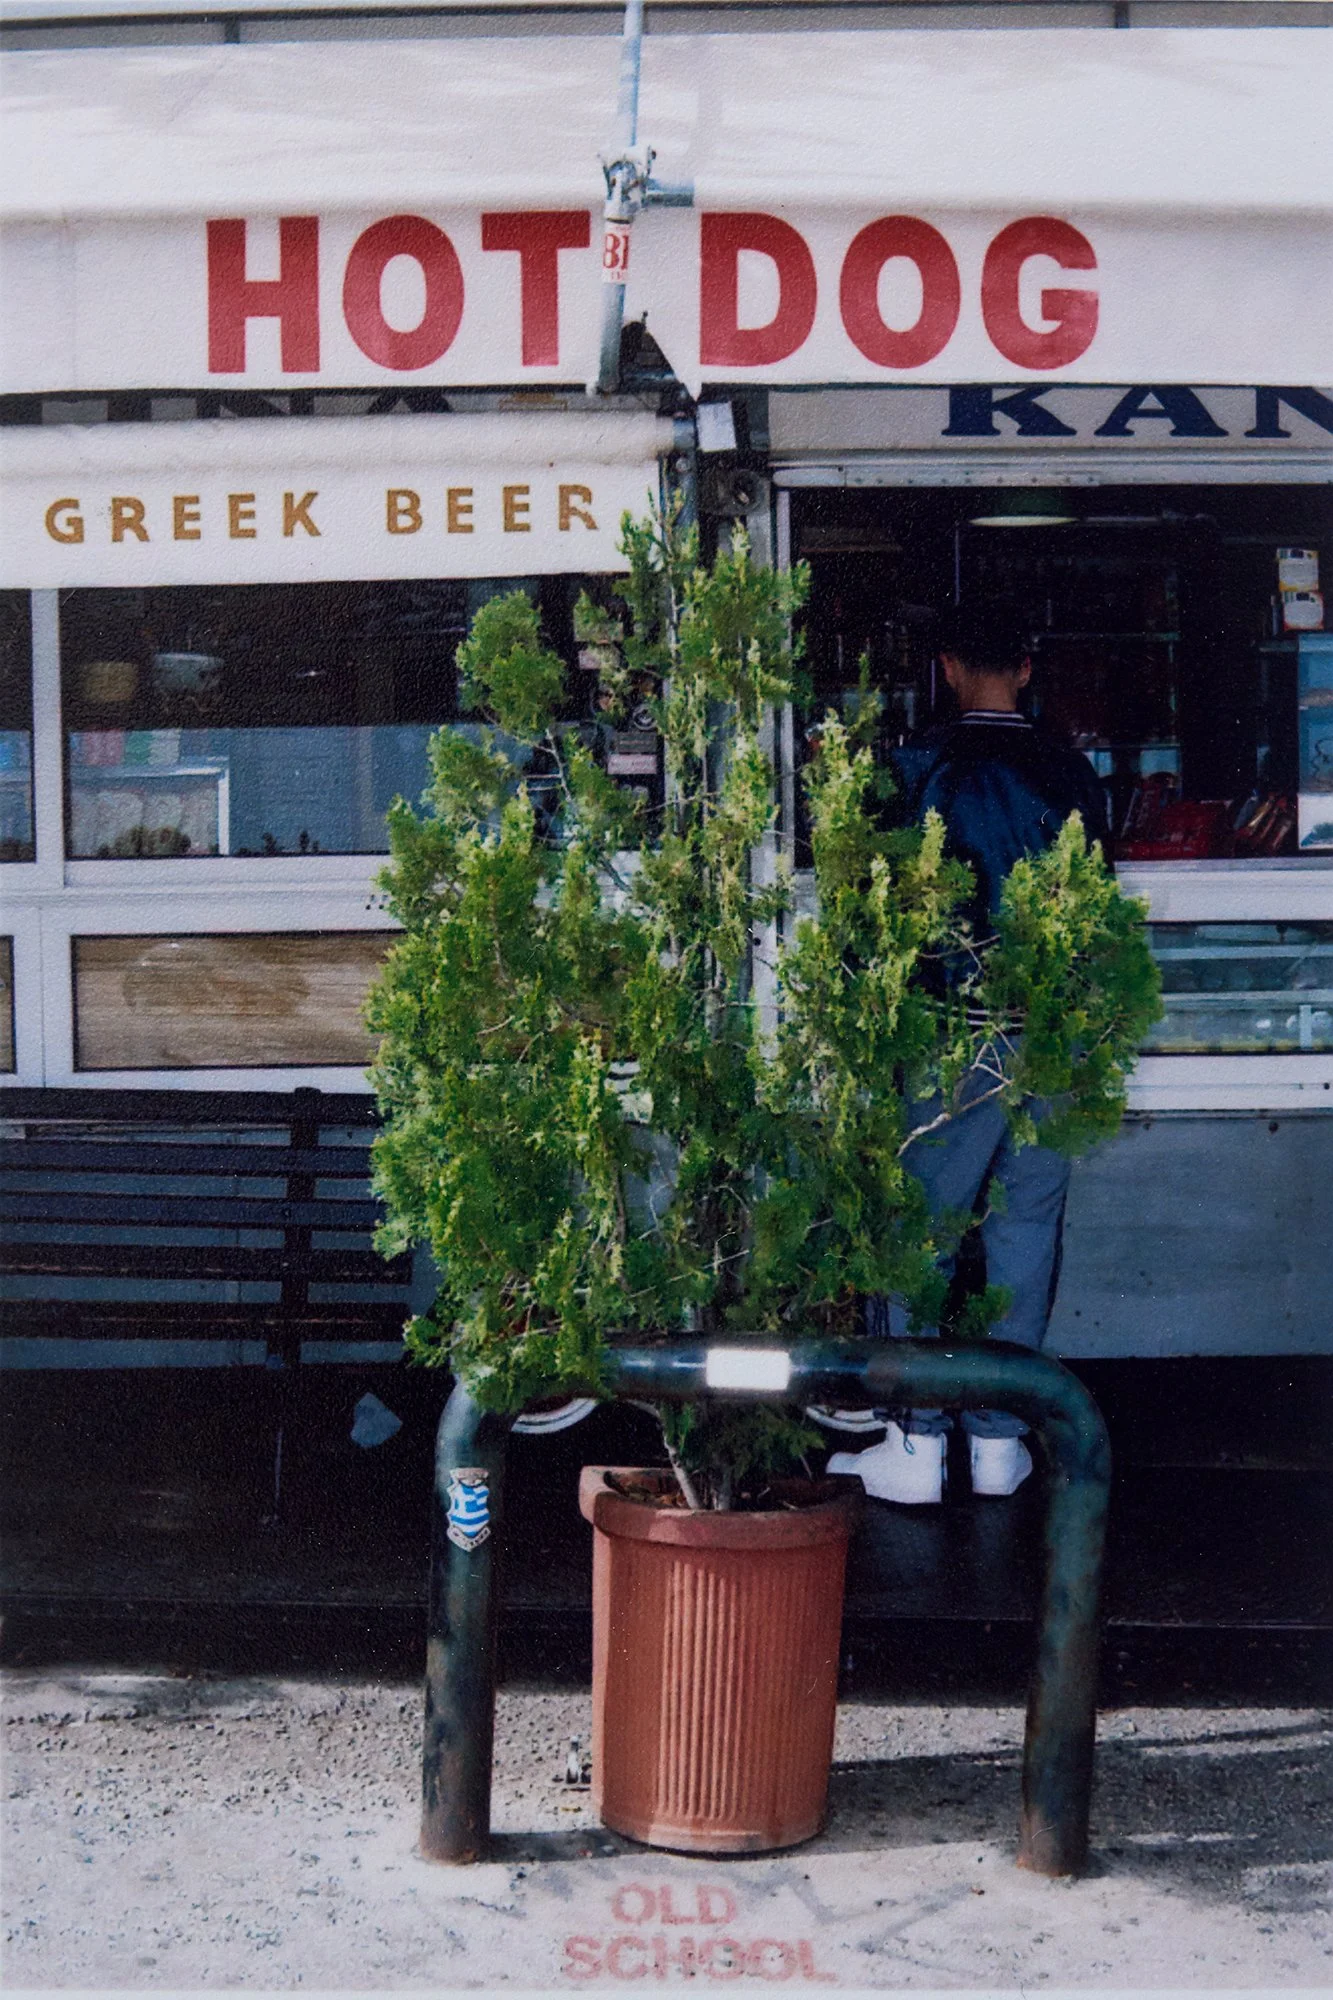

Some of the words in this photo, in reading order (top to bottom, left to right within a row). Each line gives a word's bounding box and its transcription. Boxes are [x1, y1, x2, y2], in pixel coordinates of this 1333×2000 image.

[207, 210, 592, 374] HOT
[700, 212, 1100, 371] DOG
[44, 490, 322, 545] GREEK
[386, 483, 599, 535] BEER
[611, 1882, 738, 1926] OLD
[561, 1934, 838, 1983] SCHOOL
